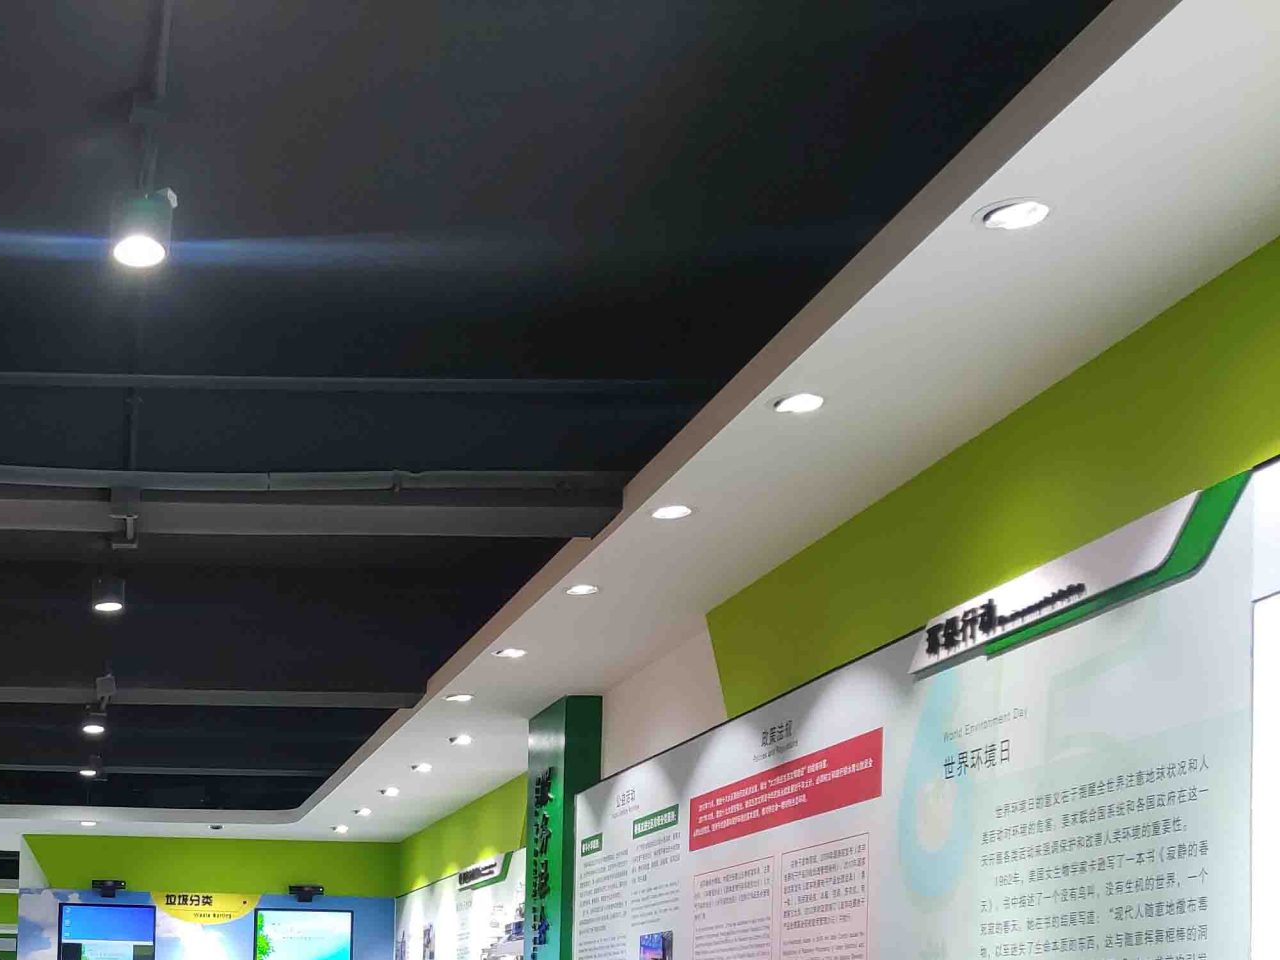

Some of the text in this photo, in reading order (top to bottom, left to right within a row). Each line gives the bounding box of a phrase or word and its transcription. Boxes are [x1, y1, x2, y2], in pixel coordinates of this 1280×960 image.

[943, 739, 1011, 781] 世界环境日
[165, 893, 213, 906] 垃圾分类
